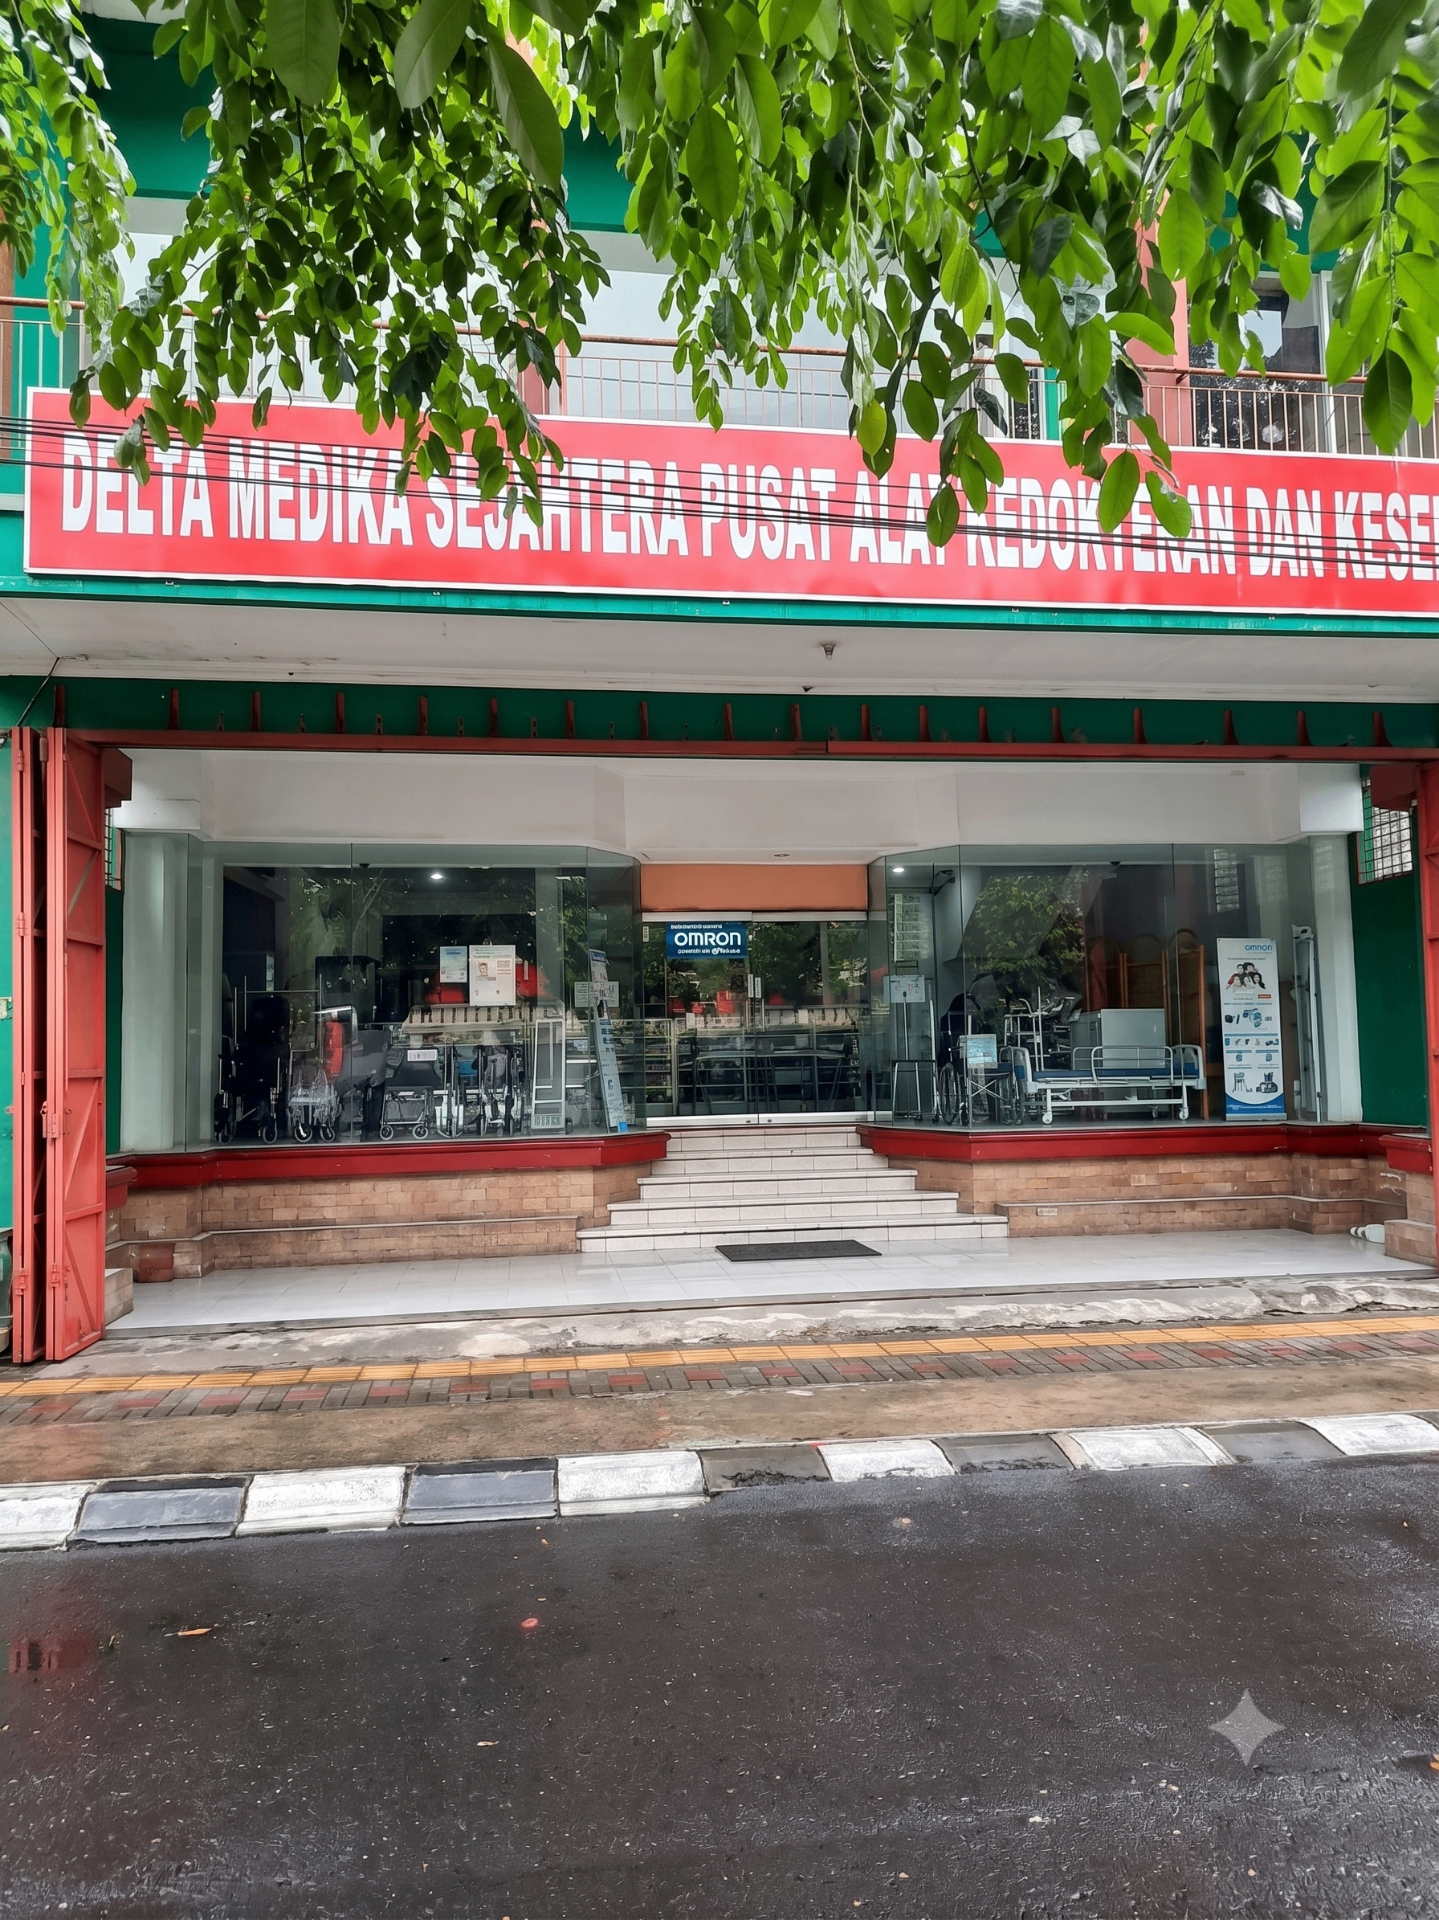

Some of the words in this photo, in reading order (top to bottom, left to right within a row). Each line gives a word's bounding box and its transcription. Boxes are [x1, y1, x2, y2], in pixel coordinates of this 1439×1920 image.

[62, 431, 214, 537] DELTA
[229, 438, 413, 546] MEDIKA
[425, 452, 689, 556] SEJAHTERA
[700, 463, 836, 561] PUSAT
[1246, 487, 1325, 578] DAN
[1334, 490, 1439, 581] KESE
